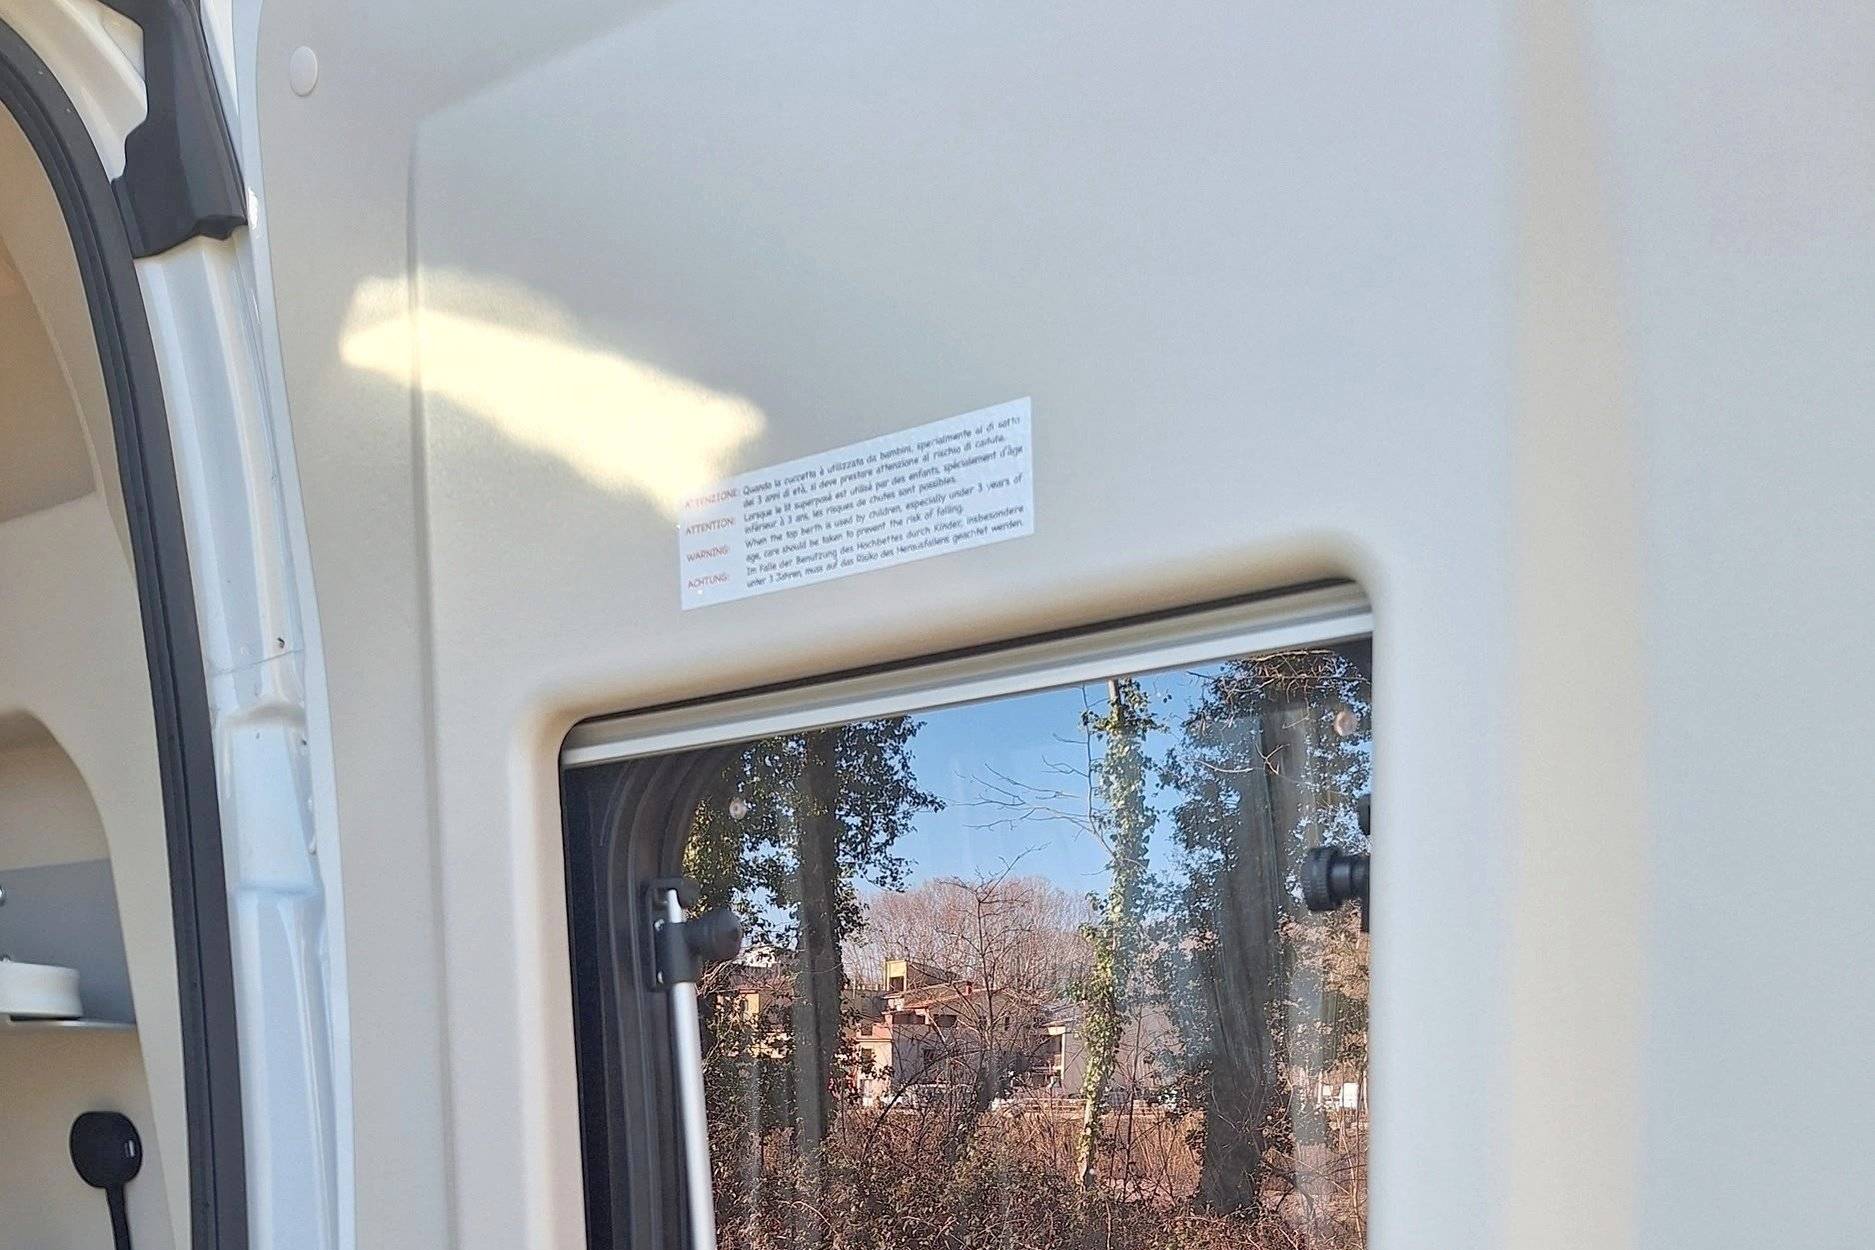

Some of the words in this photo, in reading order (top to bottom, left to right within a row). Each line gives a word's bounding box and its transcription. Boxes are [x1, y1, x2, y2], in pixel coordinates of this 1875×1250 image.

[743, 482, 772, 496] Quando
[773, 479, 781, 488] la
[784, 470, 817, 486] cuccetta
[819, 463, 825, 476] è
[827, 457, 864, 475] utilizzata
[866, 454, 878, 464] da
[917, 430, 972, 453] specialmente
[975, 425, 983, 435] al
[986, 421, 995, 433] di
[758, 494, 763, 505] 3
[782, 487, 790, 499] di
[810, 481, 817, 491] si
[819, 477, 838, 489] deve
[876, 456, 919, 475] attenzione
[921, 451, 930, 462] al
[964, 441, 972, 452] di
[744, 508, 773, 523] Lorsque
[775, 505, 782, 515] le
[784, 502, 792, 512] lit
[835, 488, 847, 500] est
[876, 479, 889, 491] par
[891, 475, 906, 486] des
[745, 536, 768, 549] When
[770, 532, 783, 542] the
[786, 528, 799, 540] top
[800, 522, 823, 536] berth
[825, 520, 832, 530] is
[834, 514, 854, 527] used
[855, 512, 866, 524] by
[905, 493, 947, 510] especially
[948, 485, 975, 499] under
[977, 482, 983, 493] 3
[987, 477, 1010, 493] years
[1013, 471, 1023, 484] of
[779, 514, 786, 527] à
[788, 514, 793, 525] 3
[812, 507, 824, 518] les
[826, 501, 854, 515] risques
[856, 499, 867, 508] de
[869, 489, 896, 504] chutes
[898, 484, 916, 497] sont
[746, 565, 758, 577] Im
[779, 558, 794, 570] der
[795, 548, 838, 566] Benutzung
[839, 544, 855, 556] des
[856, 532, 904, 551] Hochbettes
[906, 525, 931, 540] durch
[966, 503, 1025, 526] insbesondere
[746, 576, 768, 589] unter
[769, 573, 775, 584] 3
[805, 564, 824, 576] muss
[825, 559, 838, 572] auf
[839, 557, 855, 568] das
[880, 548, 895, 560] des
[952, 525, 988, 545] geachtet
[763, 546, 780, 558] care
[782, 540, 808, 554] should
[809, 537, 819, 547] be
[821, 532, 843, 545] taken
[846, 528, 855, 539] to
[856, 520, 887, 538] prevent
[889, 518, 904, 529] the
[905, 510, 921, 525] risk
[924, 507, 935, 520] of
